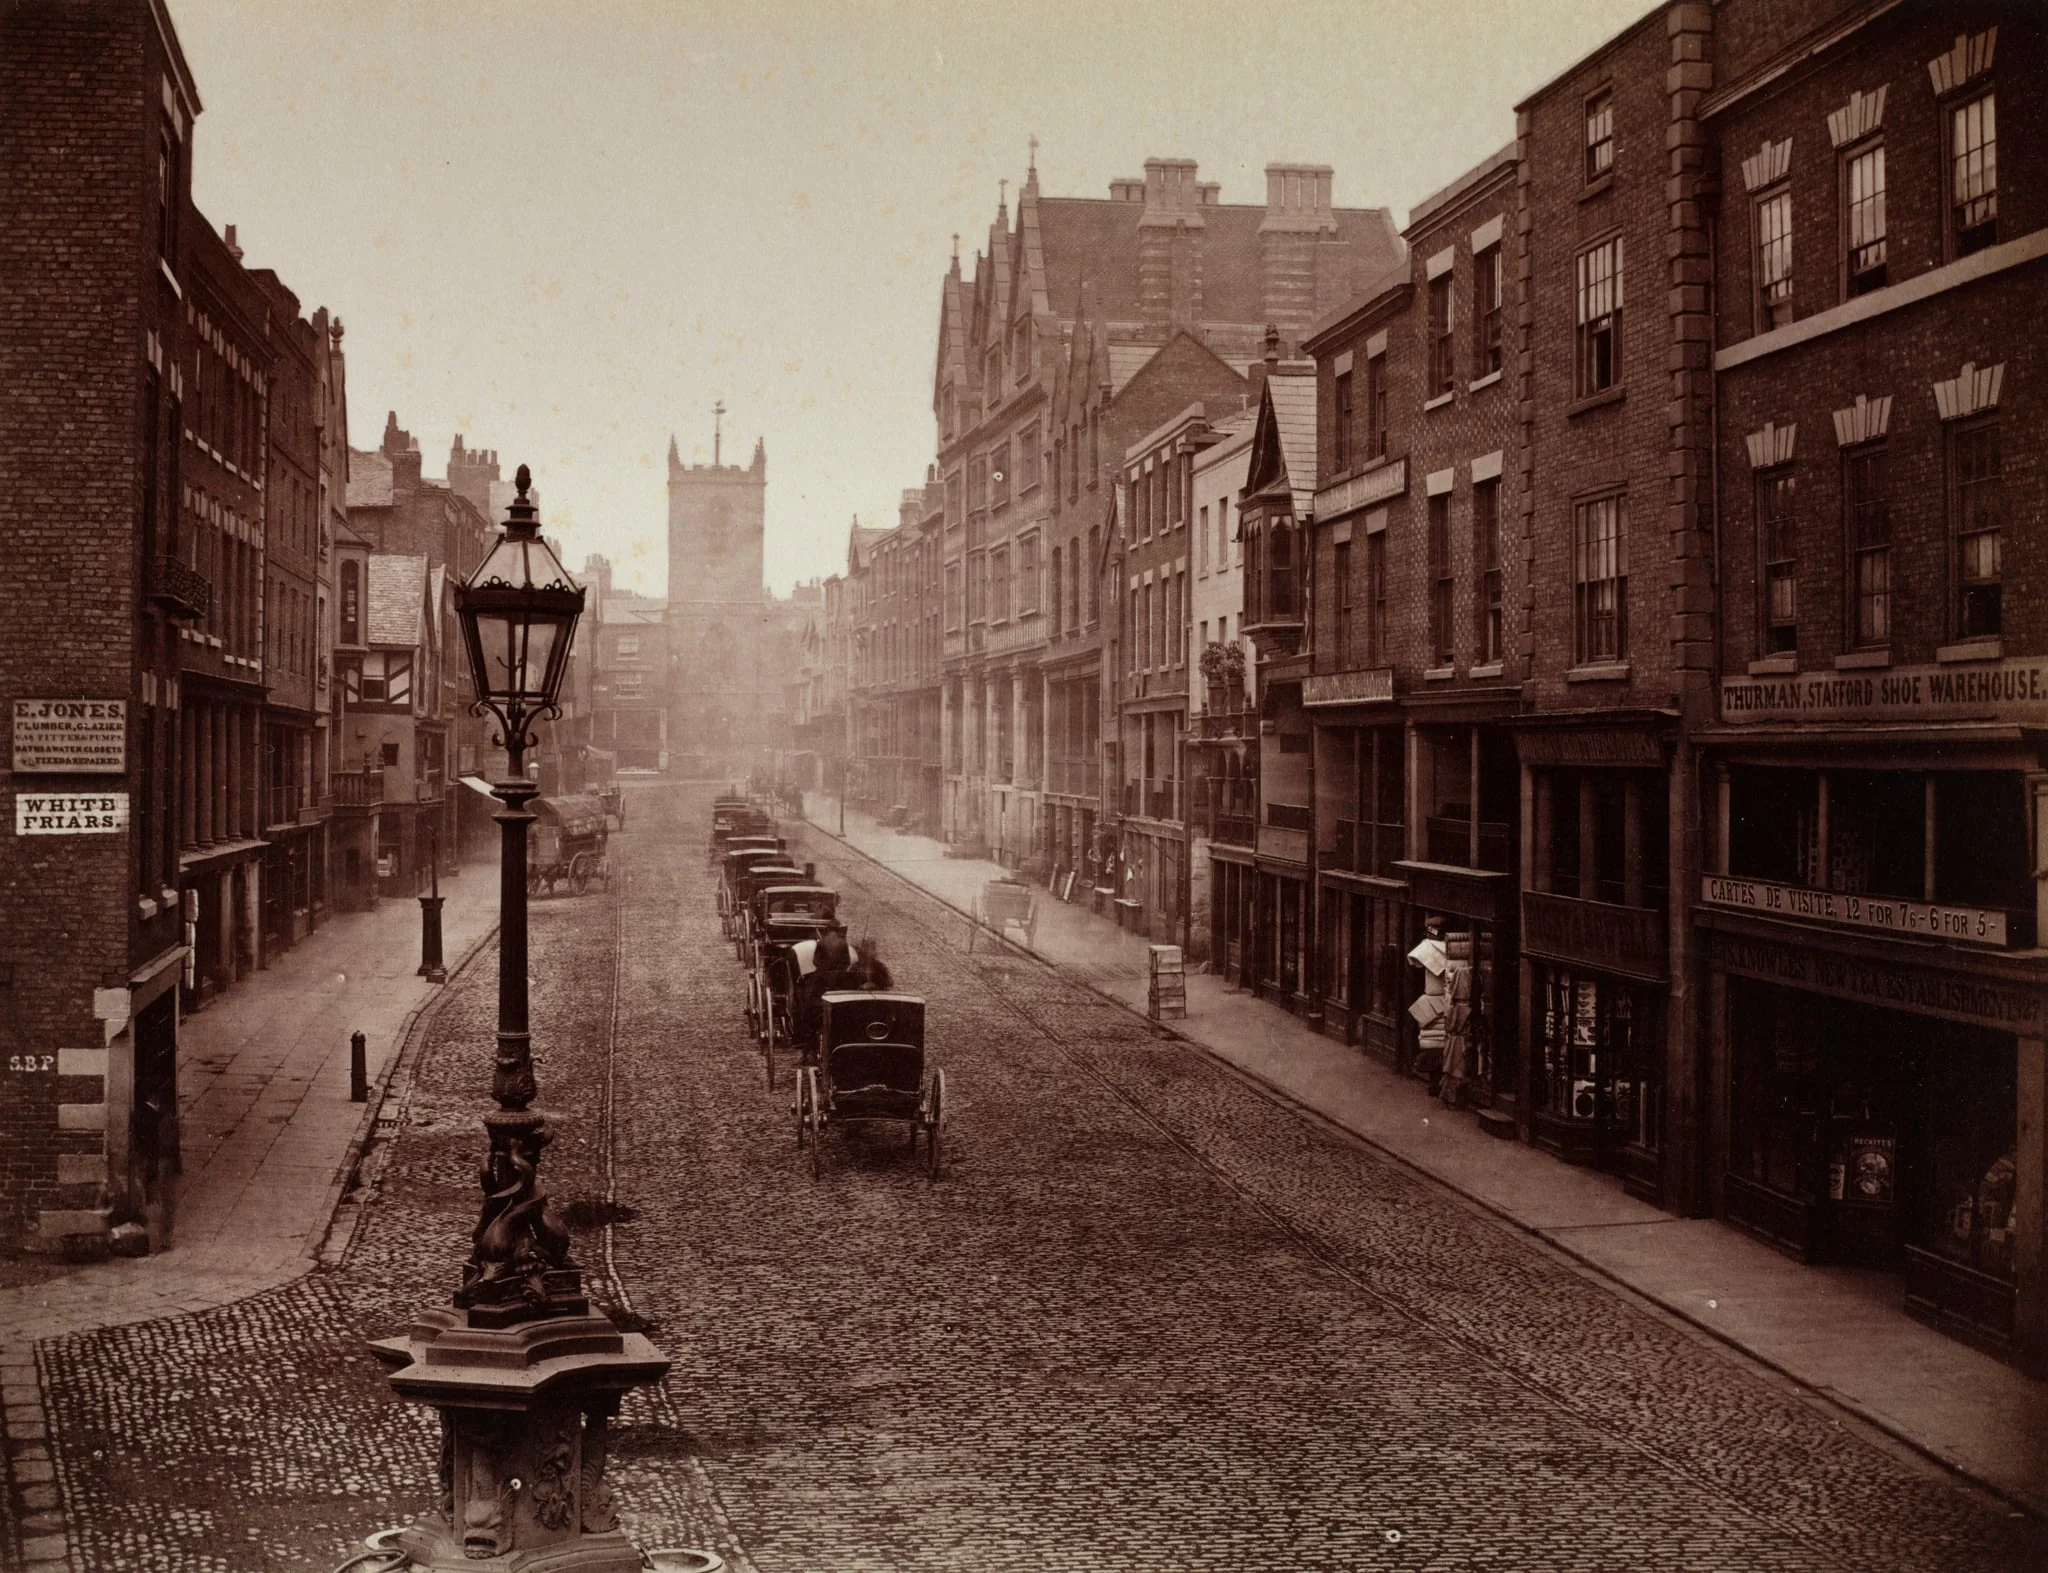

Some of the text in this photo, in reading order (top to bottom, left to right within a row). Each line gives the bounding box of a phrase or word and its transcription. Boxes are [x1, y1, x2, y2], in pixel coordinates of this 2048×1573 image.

[1808, 679, 1873, 708] STAFFORD
[1881, 676, 1921, 704] SHOE
[77, 722, 123, 731] GLAZIER
[25, 798, 115, 812] WHITE
[1711, 879, 1755, 905] CARTES
[1766, 886, 1781, 908] DE
[1845, 896, 1859, 920] 12
[1868, 904, 1892, 926] FOR
[1944, 912, 1968, 935] FOR
